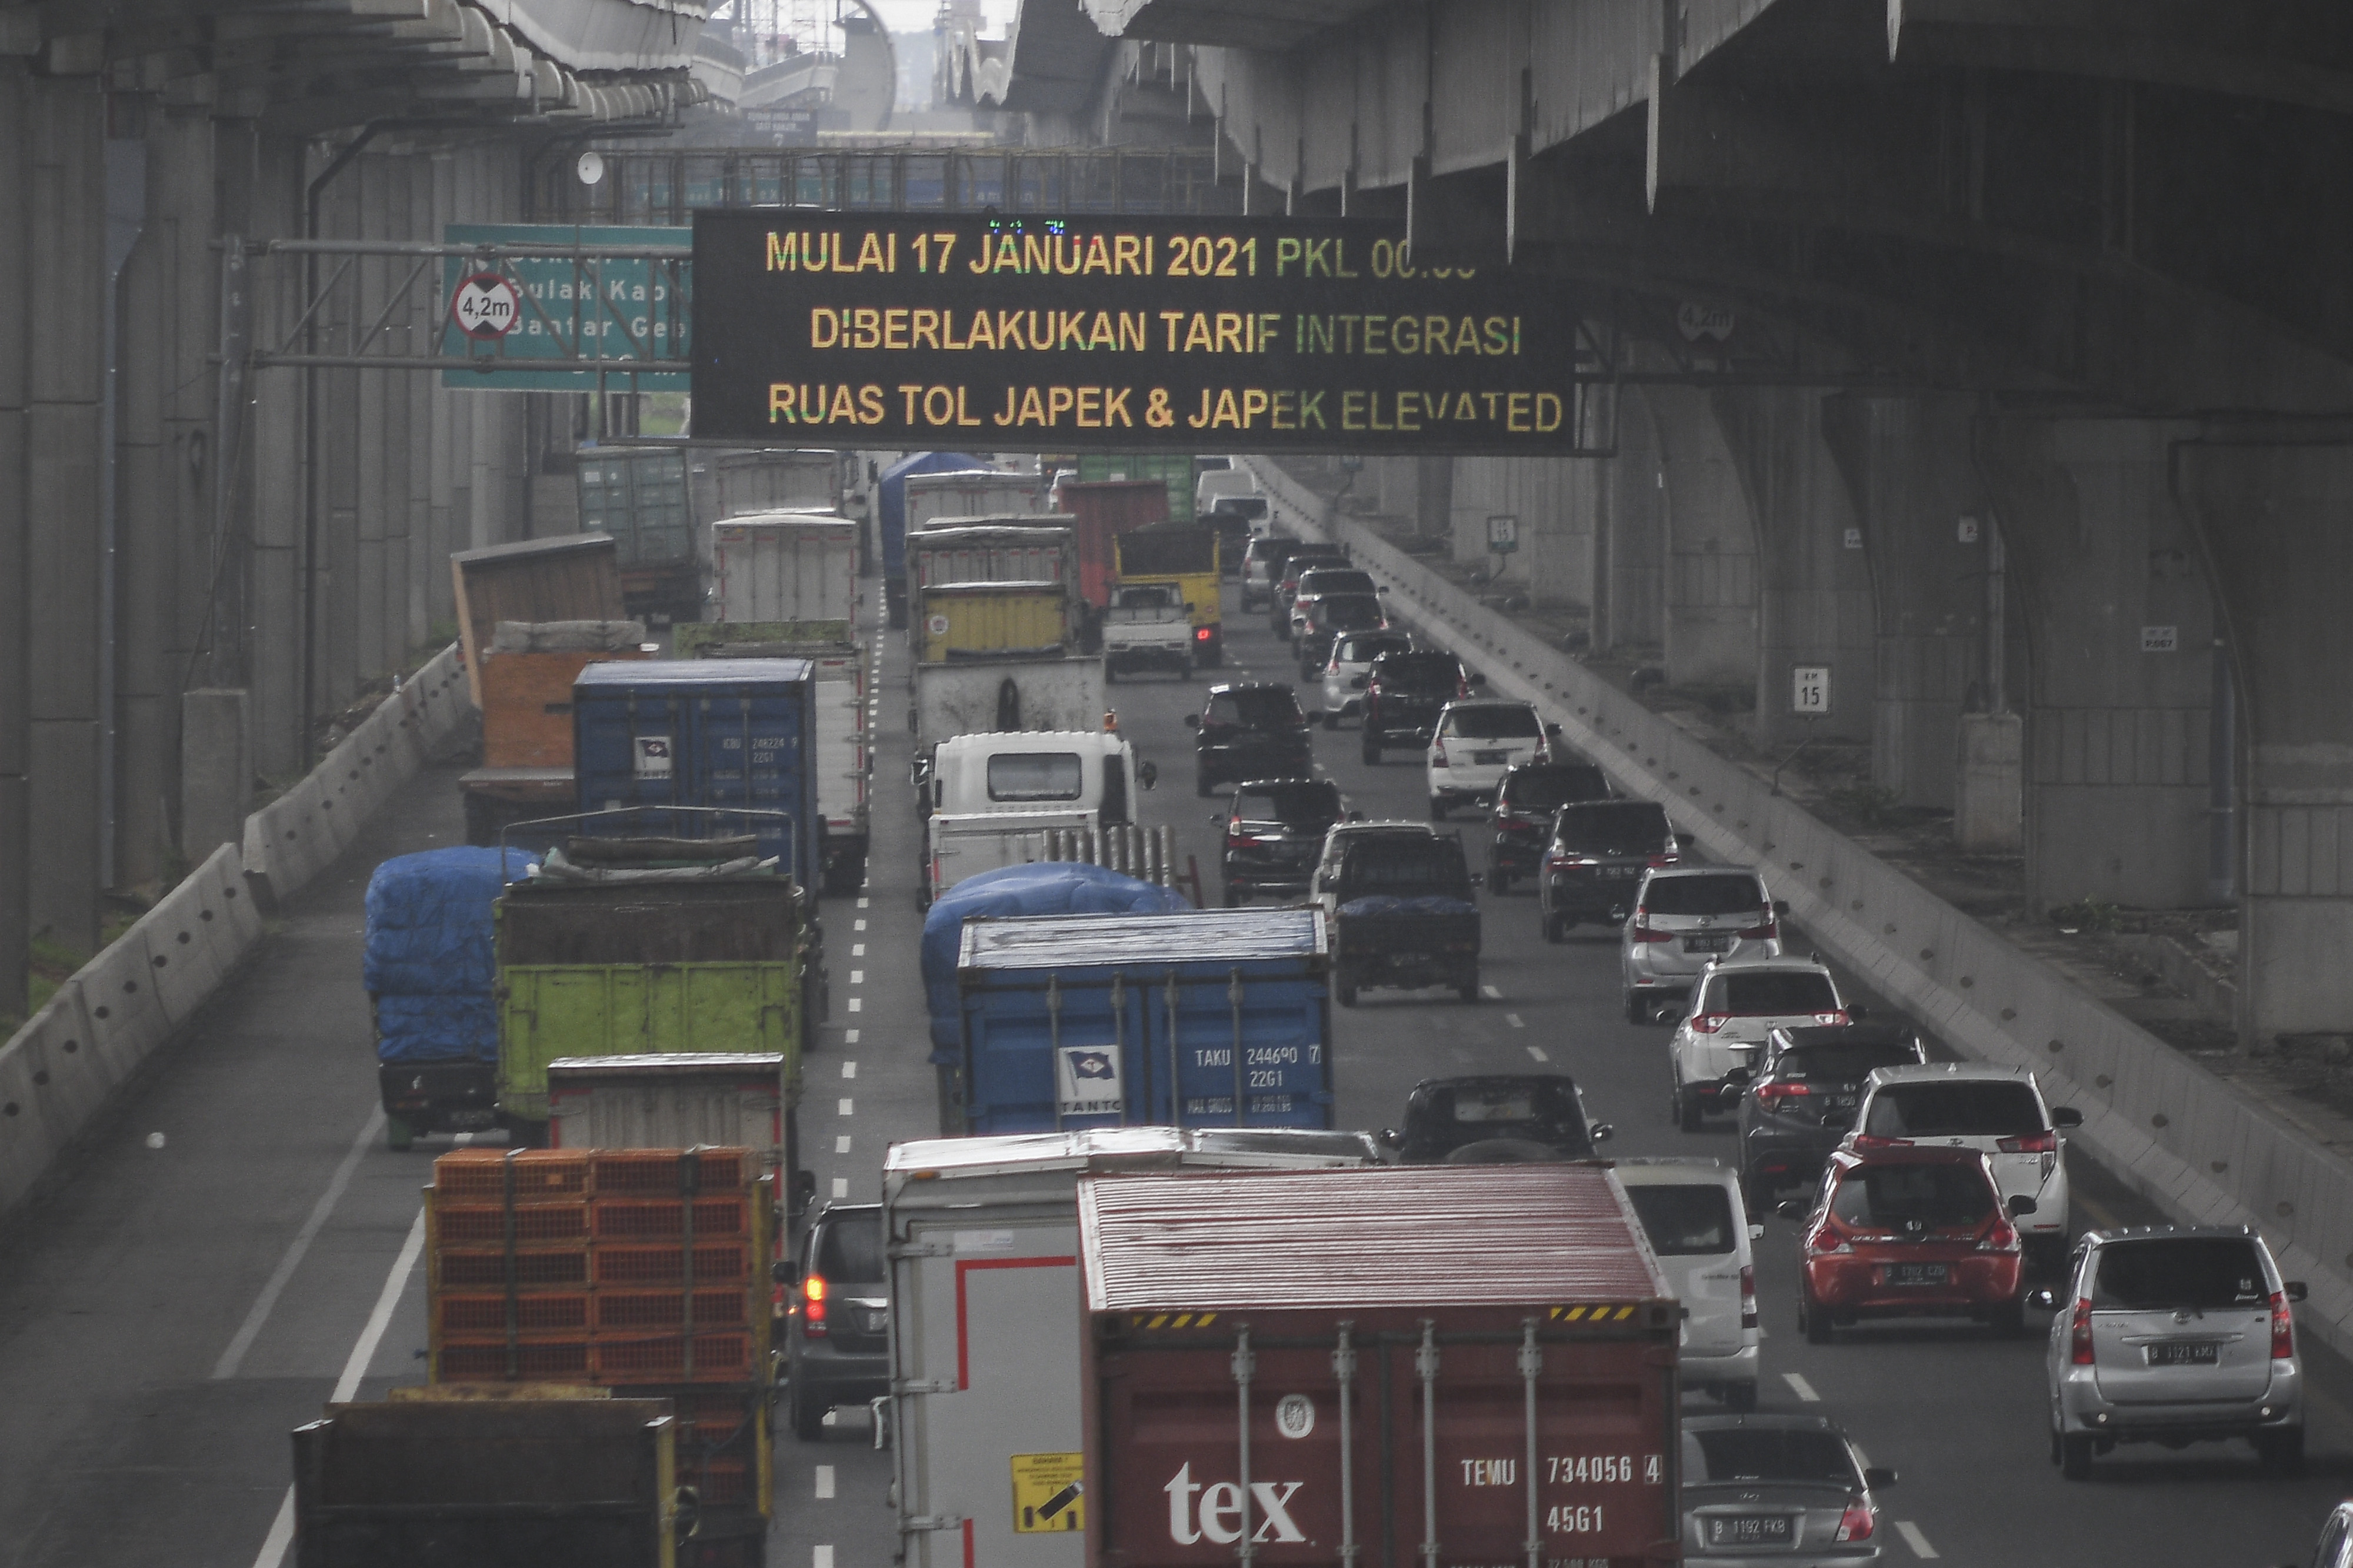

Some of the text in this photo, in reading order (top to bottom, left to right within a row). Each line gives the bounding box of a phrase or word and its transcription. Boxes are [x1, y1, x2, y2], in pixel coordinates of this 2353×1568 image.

[766, 232, 1475, 279] MULAI 17 JANUARI 2021 PKL 00.
[463, 297, 509, 319] 4,2m
[811, 309, 1520, 355] DIBERLAKUKAN TARIF INTEGRASI
[769, 383, 1563, 432] RUAS TOL JAPEK & JAPEK ELEVATED
[1802, 686, 1819, 705] 15
[1196, 1049, 1231, 1067] TAKU
[1309, 1045, 1320, 1064] 7
[1249, 1070, 1283, 1087] 22G1
[1461, 1456, 1661, 1486] TEMU 734056 4
[1164, 1461, 1306, 1545] tex
[1547, 1506, 1602, 1532] 45G1
[1715, 1520, 1723, 1534] B
